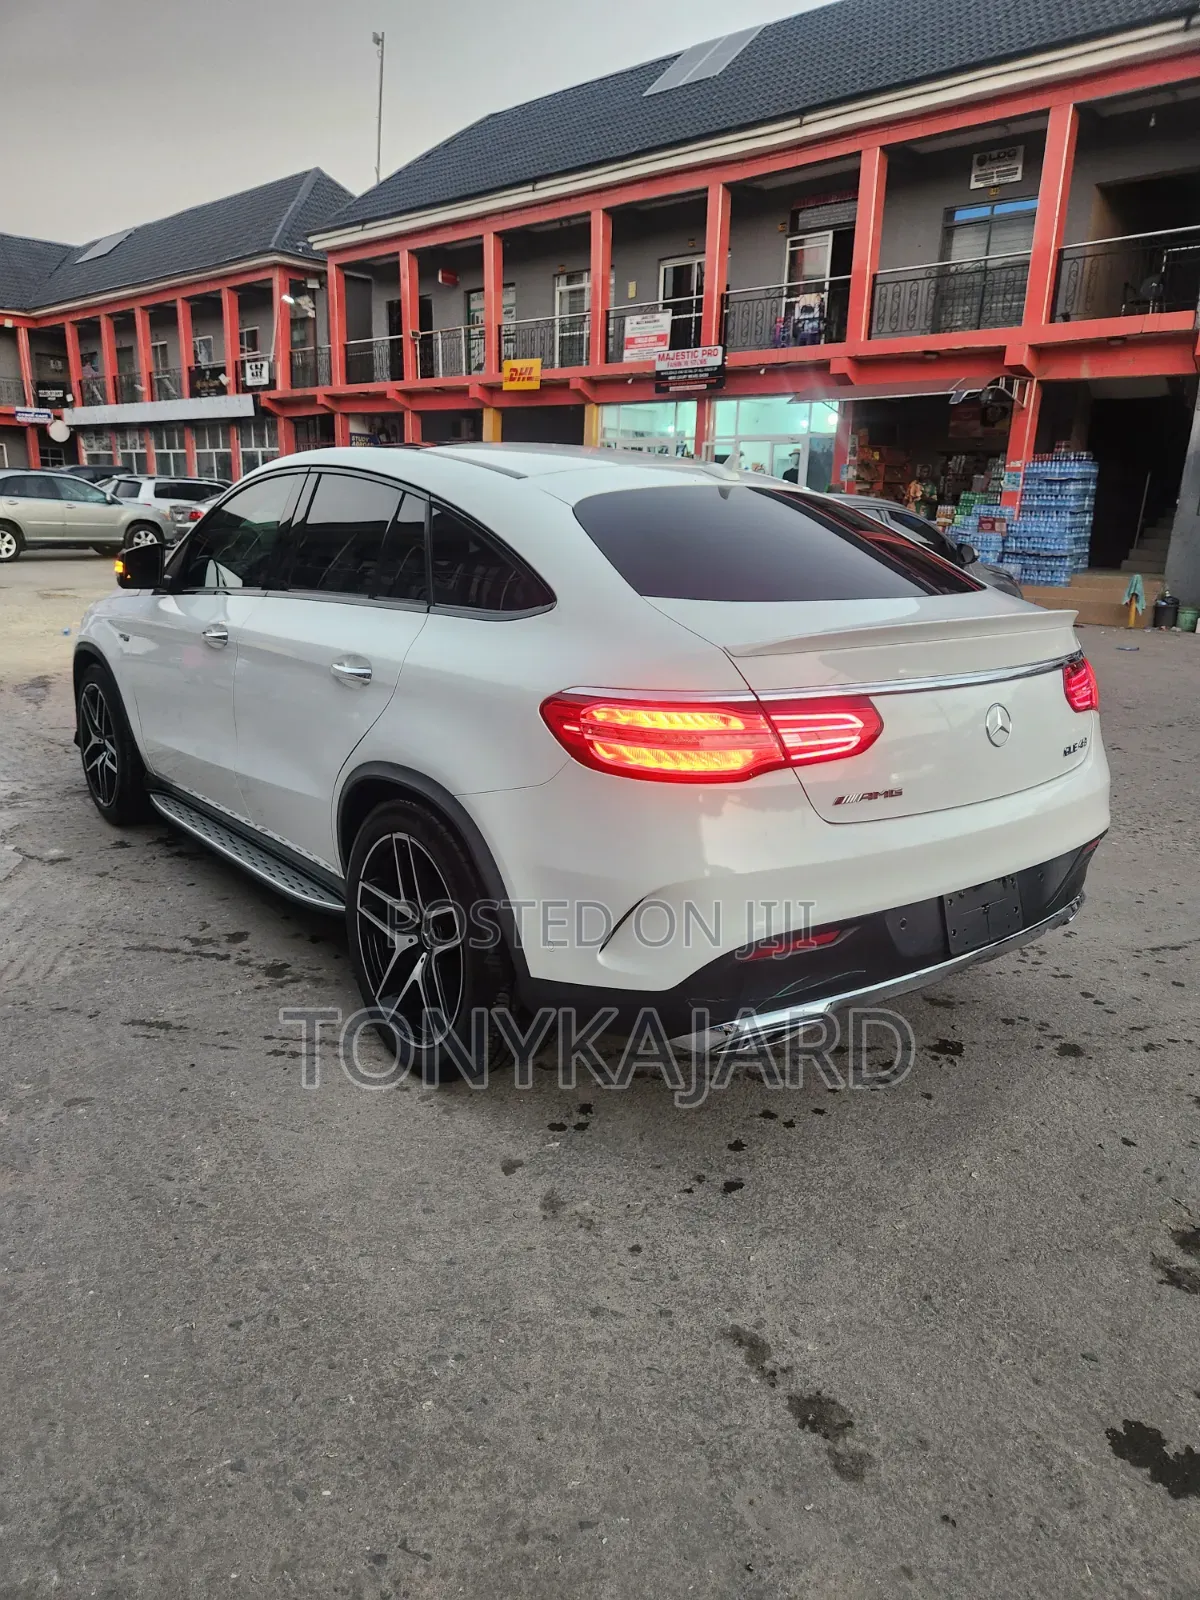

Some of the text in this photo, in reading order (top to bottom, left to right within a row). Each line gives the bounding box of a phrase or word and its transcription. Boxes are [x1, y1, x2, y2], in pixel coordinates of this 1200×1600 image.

[658, 350, 699, 361] MAJESTIC
[702, 348, 718, 357] PRO
[509, 367, 534, 382] DHL
